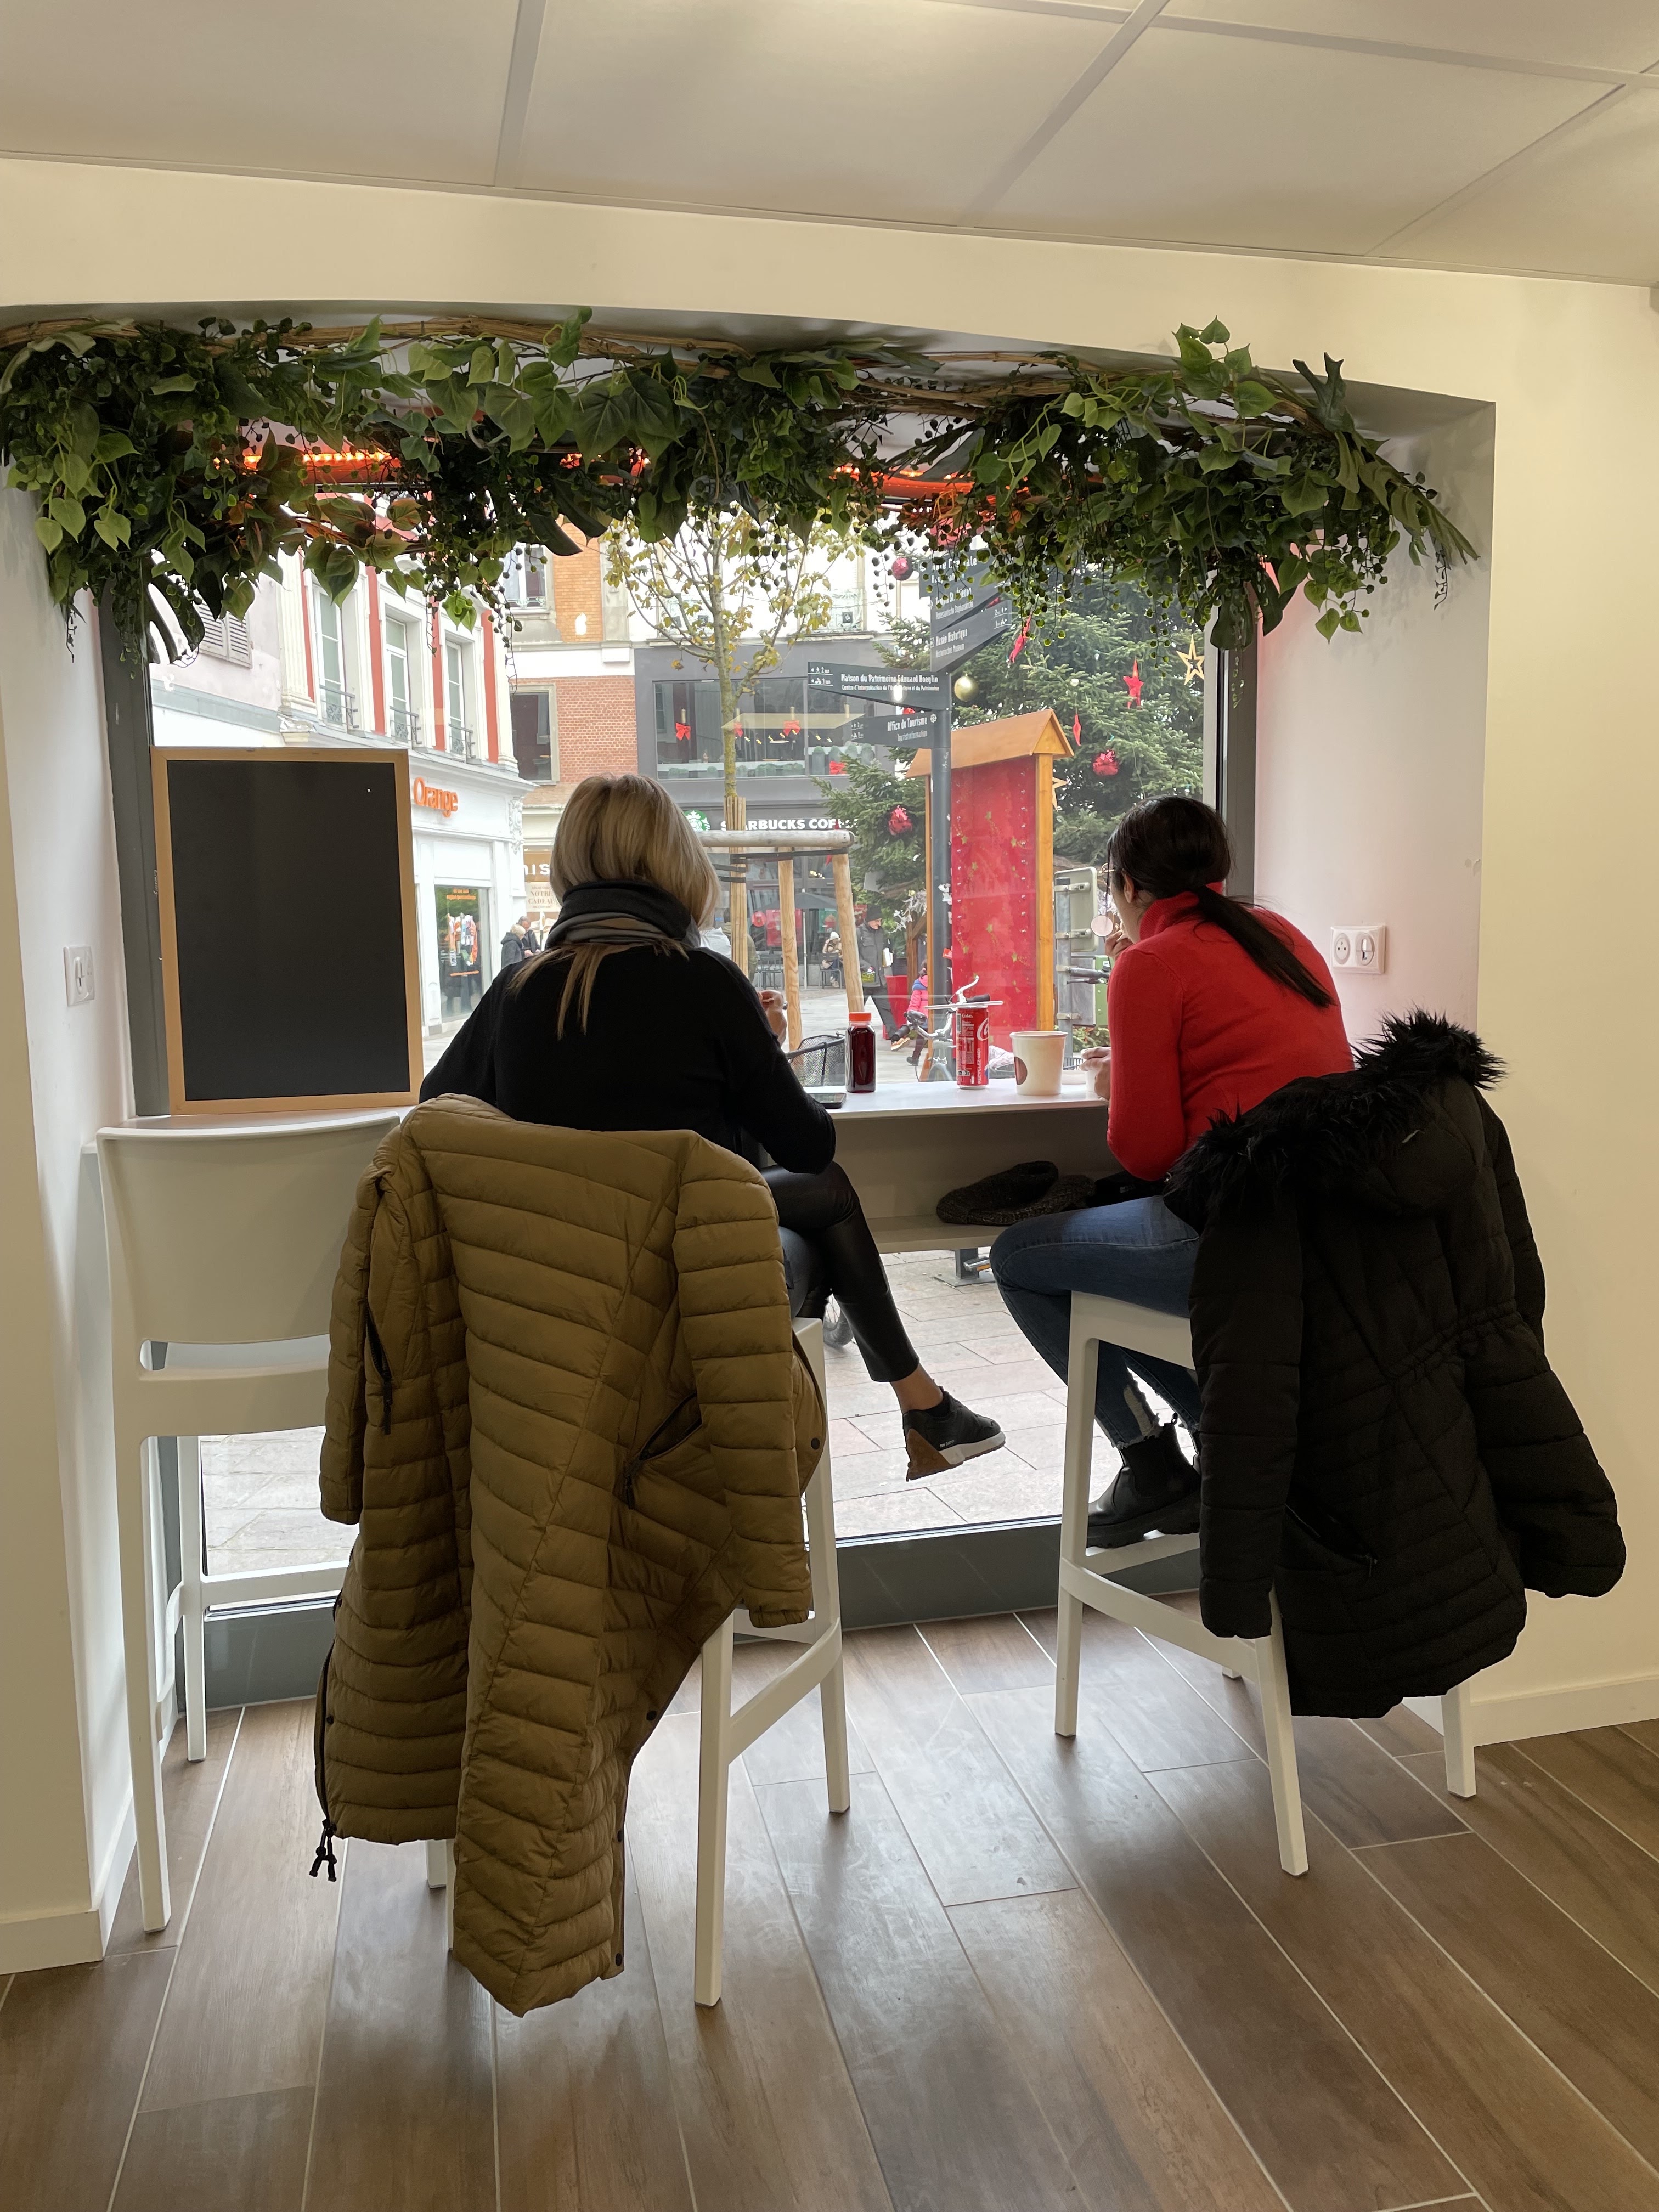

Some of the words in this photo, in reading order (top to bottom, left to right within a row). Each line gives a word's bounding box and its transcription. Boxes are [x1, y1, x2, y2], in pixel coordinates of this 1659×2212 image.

[841, 674, 859, 682] Maison
[861, 674, 867, 682] du
[868, 674, 897, 682] Patrimoine
[919, 675, 939, 684] Boeglin
[887, 721, 900, 731] Office
[901, 719, 906, 729] de
[907, 716, 927, 728] Tourisme
[413, 776, 458, 818] Orange
